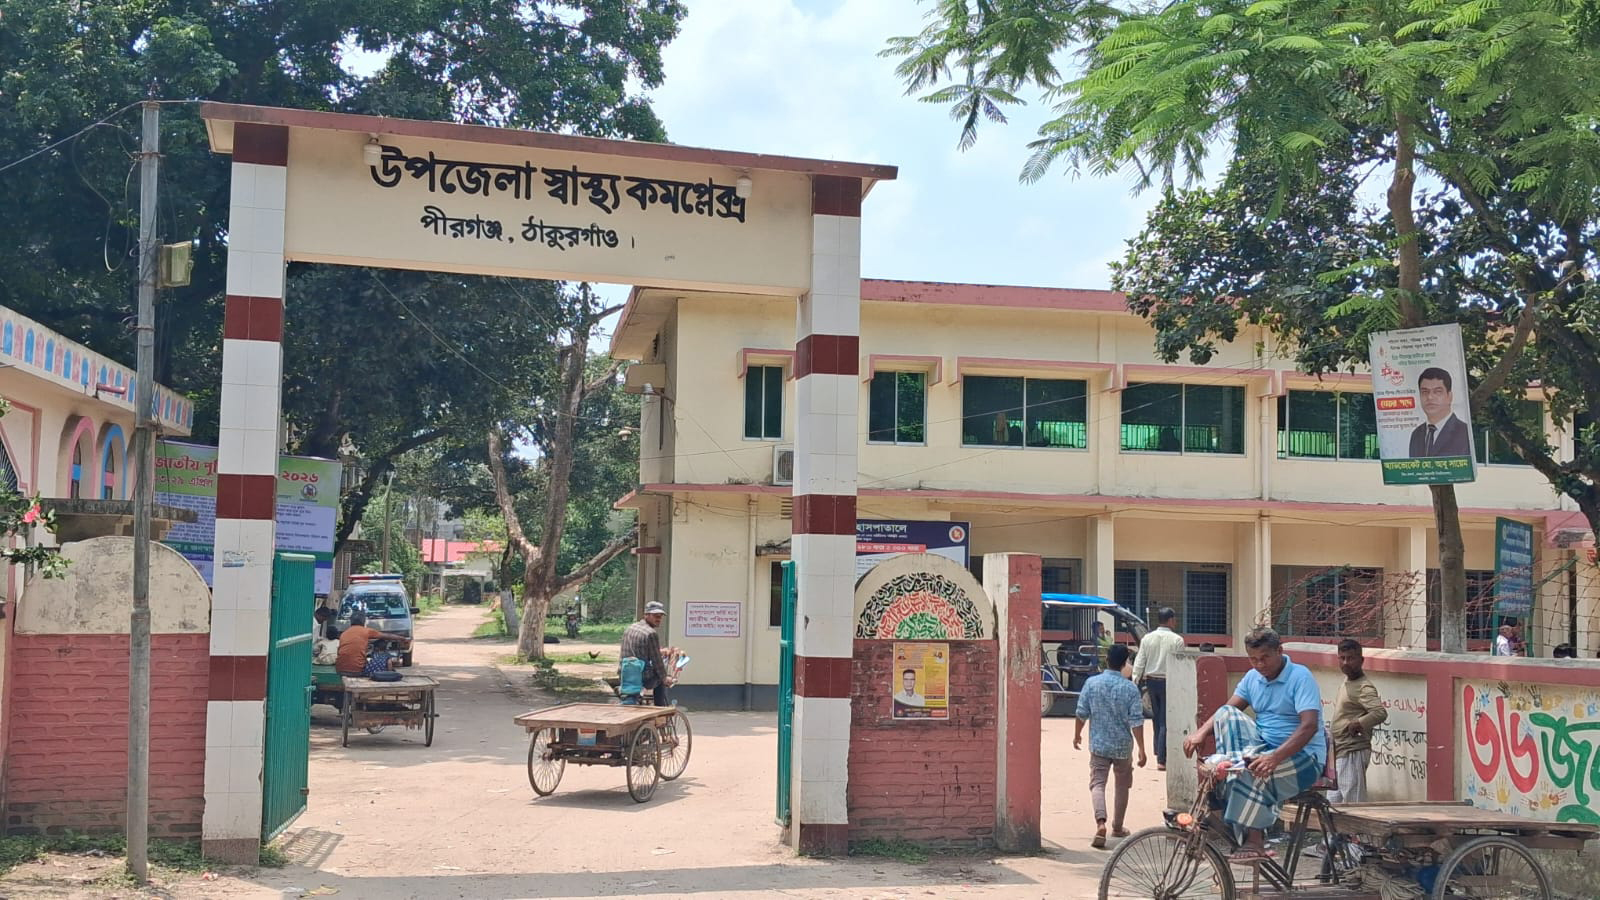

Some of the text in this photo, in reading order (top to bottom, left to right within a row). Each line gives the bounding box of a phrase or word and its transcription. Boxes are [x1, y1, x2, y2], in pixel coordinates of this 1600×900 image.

[370, 145, 746, 223] উপজেলা স্বাস্থ্য কমপ্লেক্স
